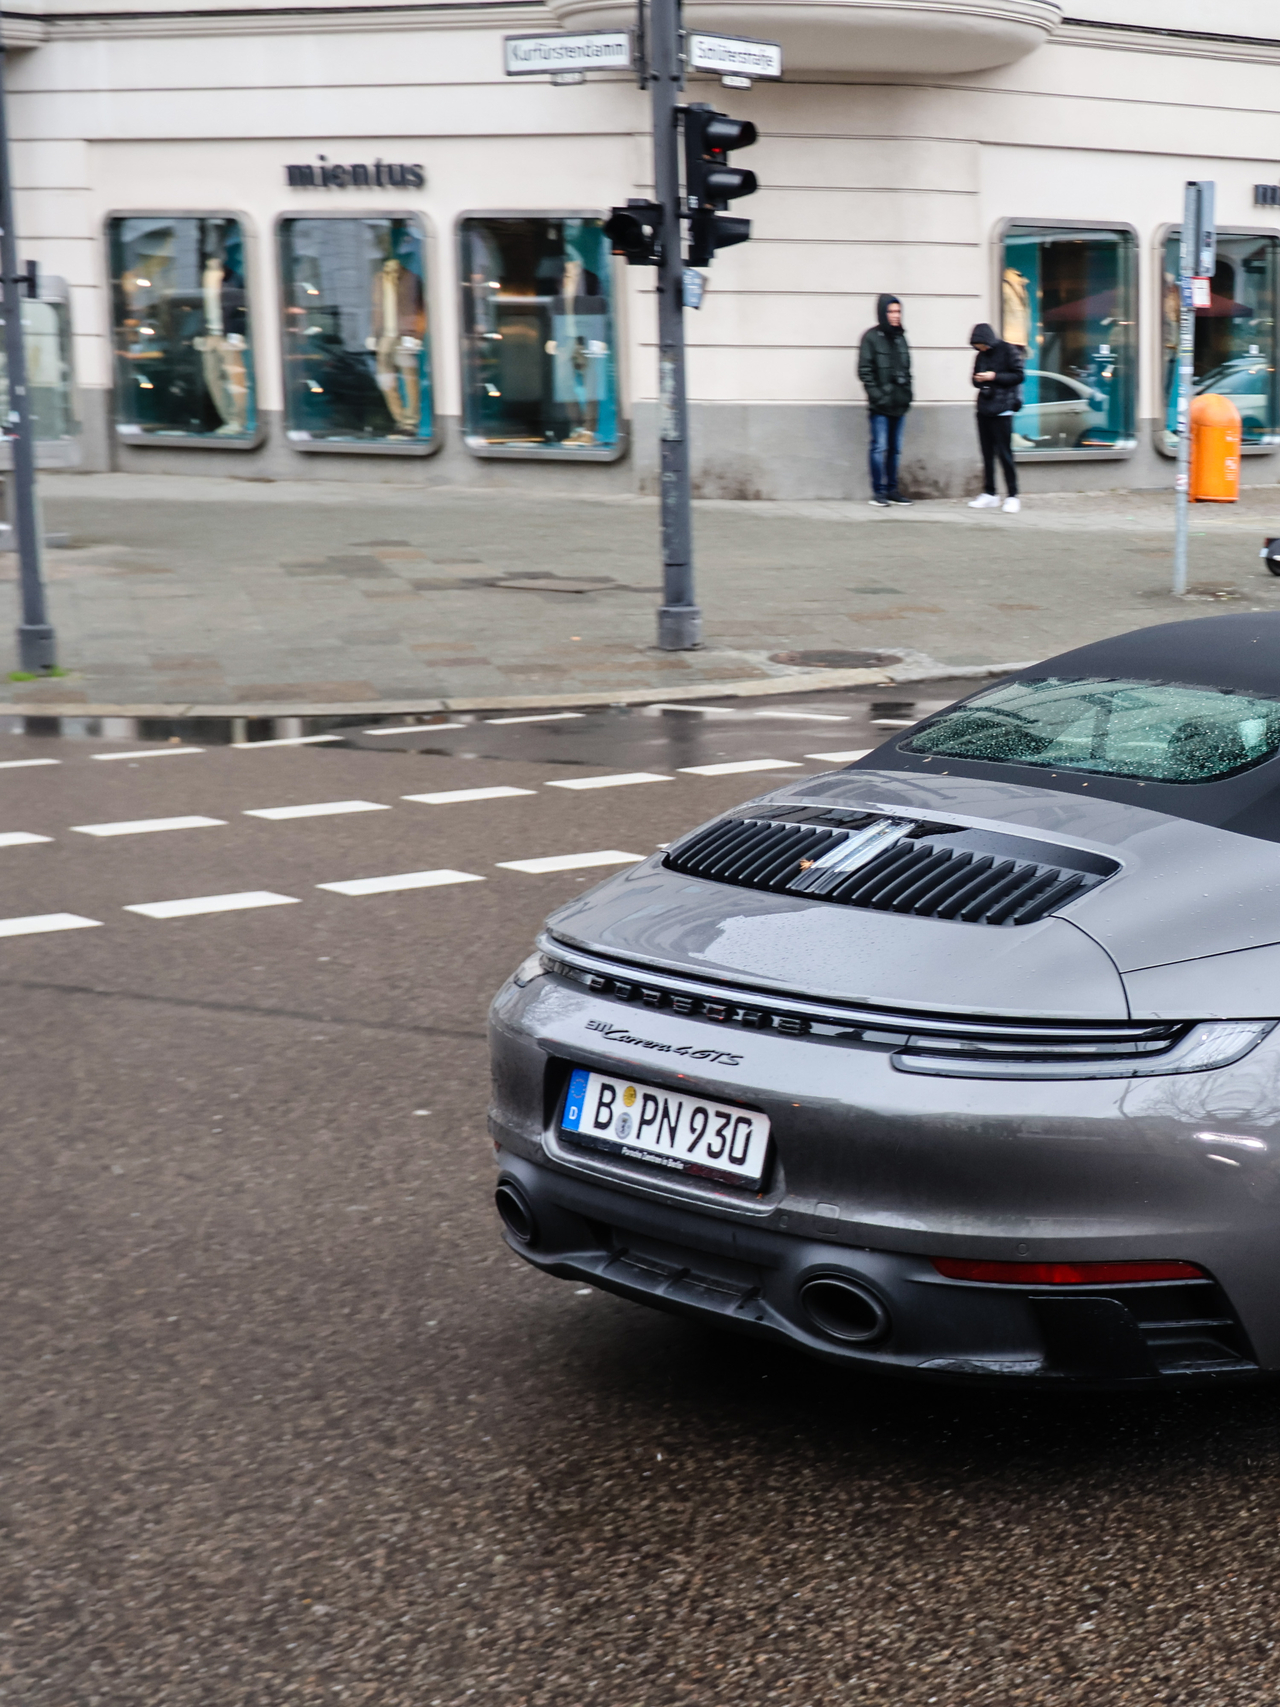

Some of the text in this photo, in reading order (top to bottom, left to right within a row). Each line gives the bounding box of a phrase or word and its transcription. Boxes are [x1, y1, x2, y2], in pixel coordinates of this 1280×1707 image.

[508, 39, 627, 61] Kurfürstendamm
[285, 154, 424, 187] mientus
[589, 977, 803, 1036] PORSCHE
[585, 1018, 744, 1066] 911 Carrera 4 GTS
[568, 1106, 578, 1120] D
[593, 1083, 753, 1166] B PN 930
